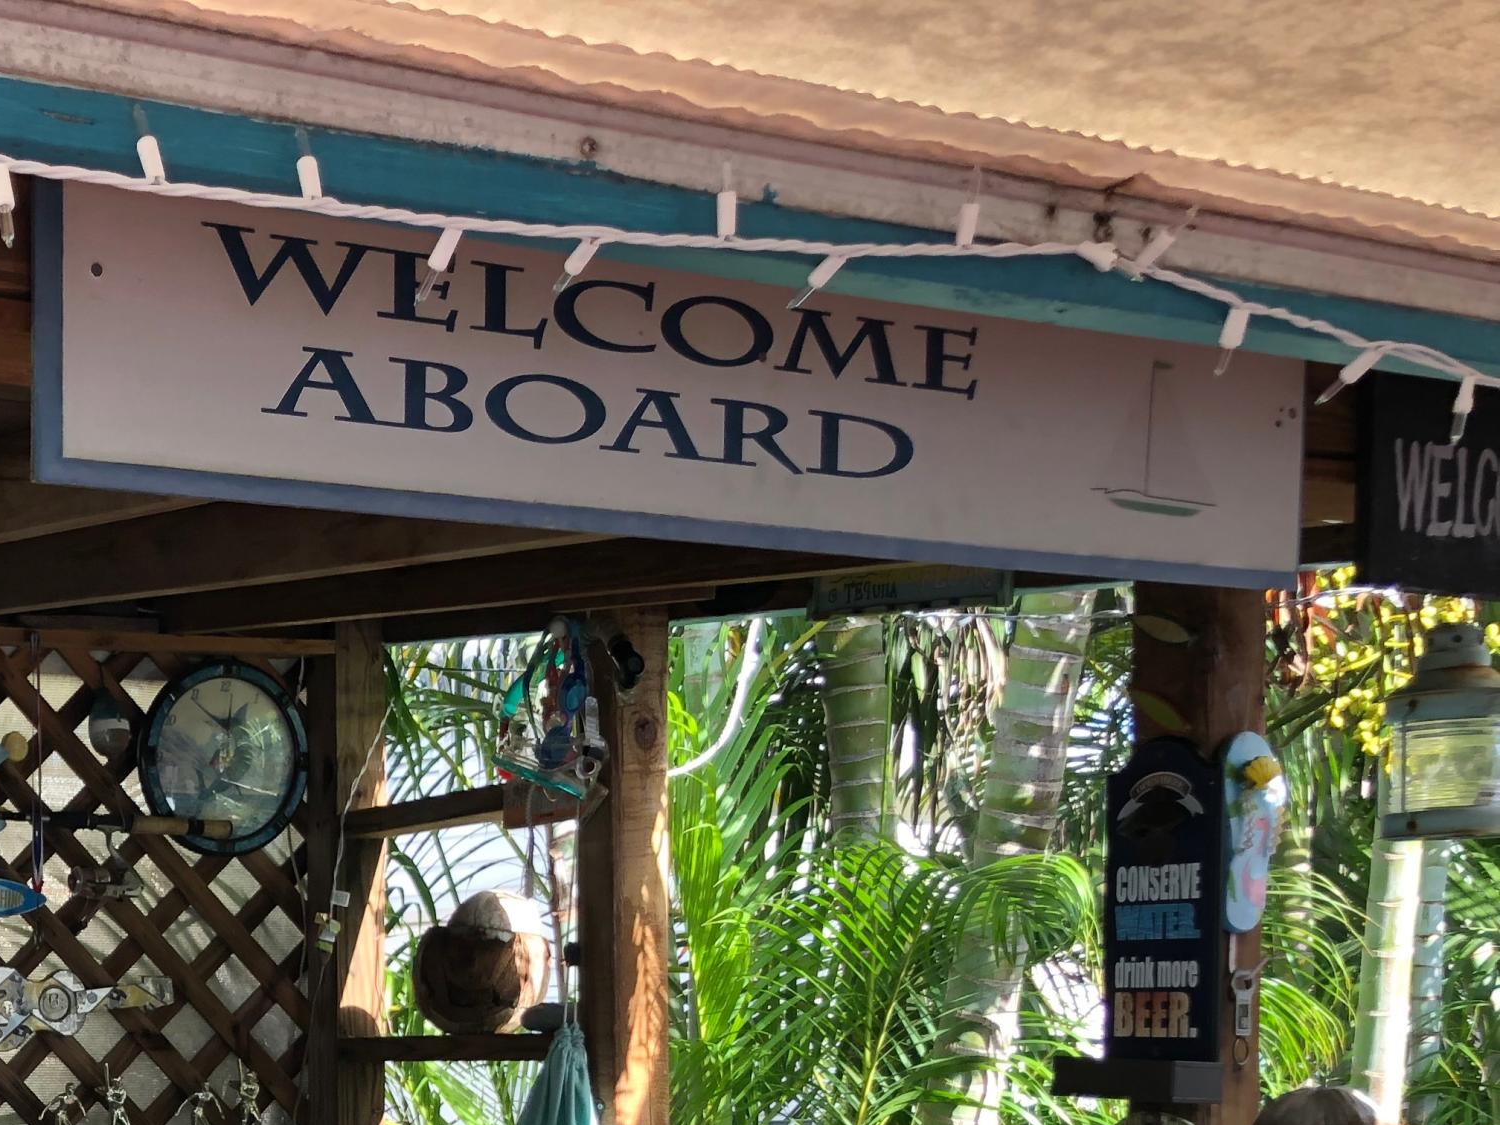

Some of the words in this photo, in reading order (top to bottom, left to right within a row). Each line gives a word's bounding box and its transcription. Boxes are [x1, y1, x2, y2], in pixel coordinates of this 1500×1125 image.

[202, 221, 981, 400] WELCOME
[260, 346, 914, 479] ABOARD
[1394, 437, 1500, 539] WELC
[1115, 862, 1202, 903] CONSERVE
[1115, 956, 1155, 988] drink
[1156, 960, 1199, 988] more
